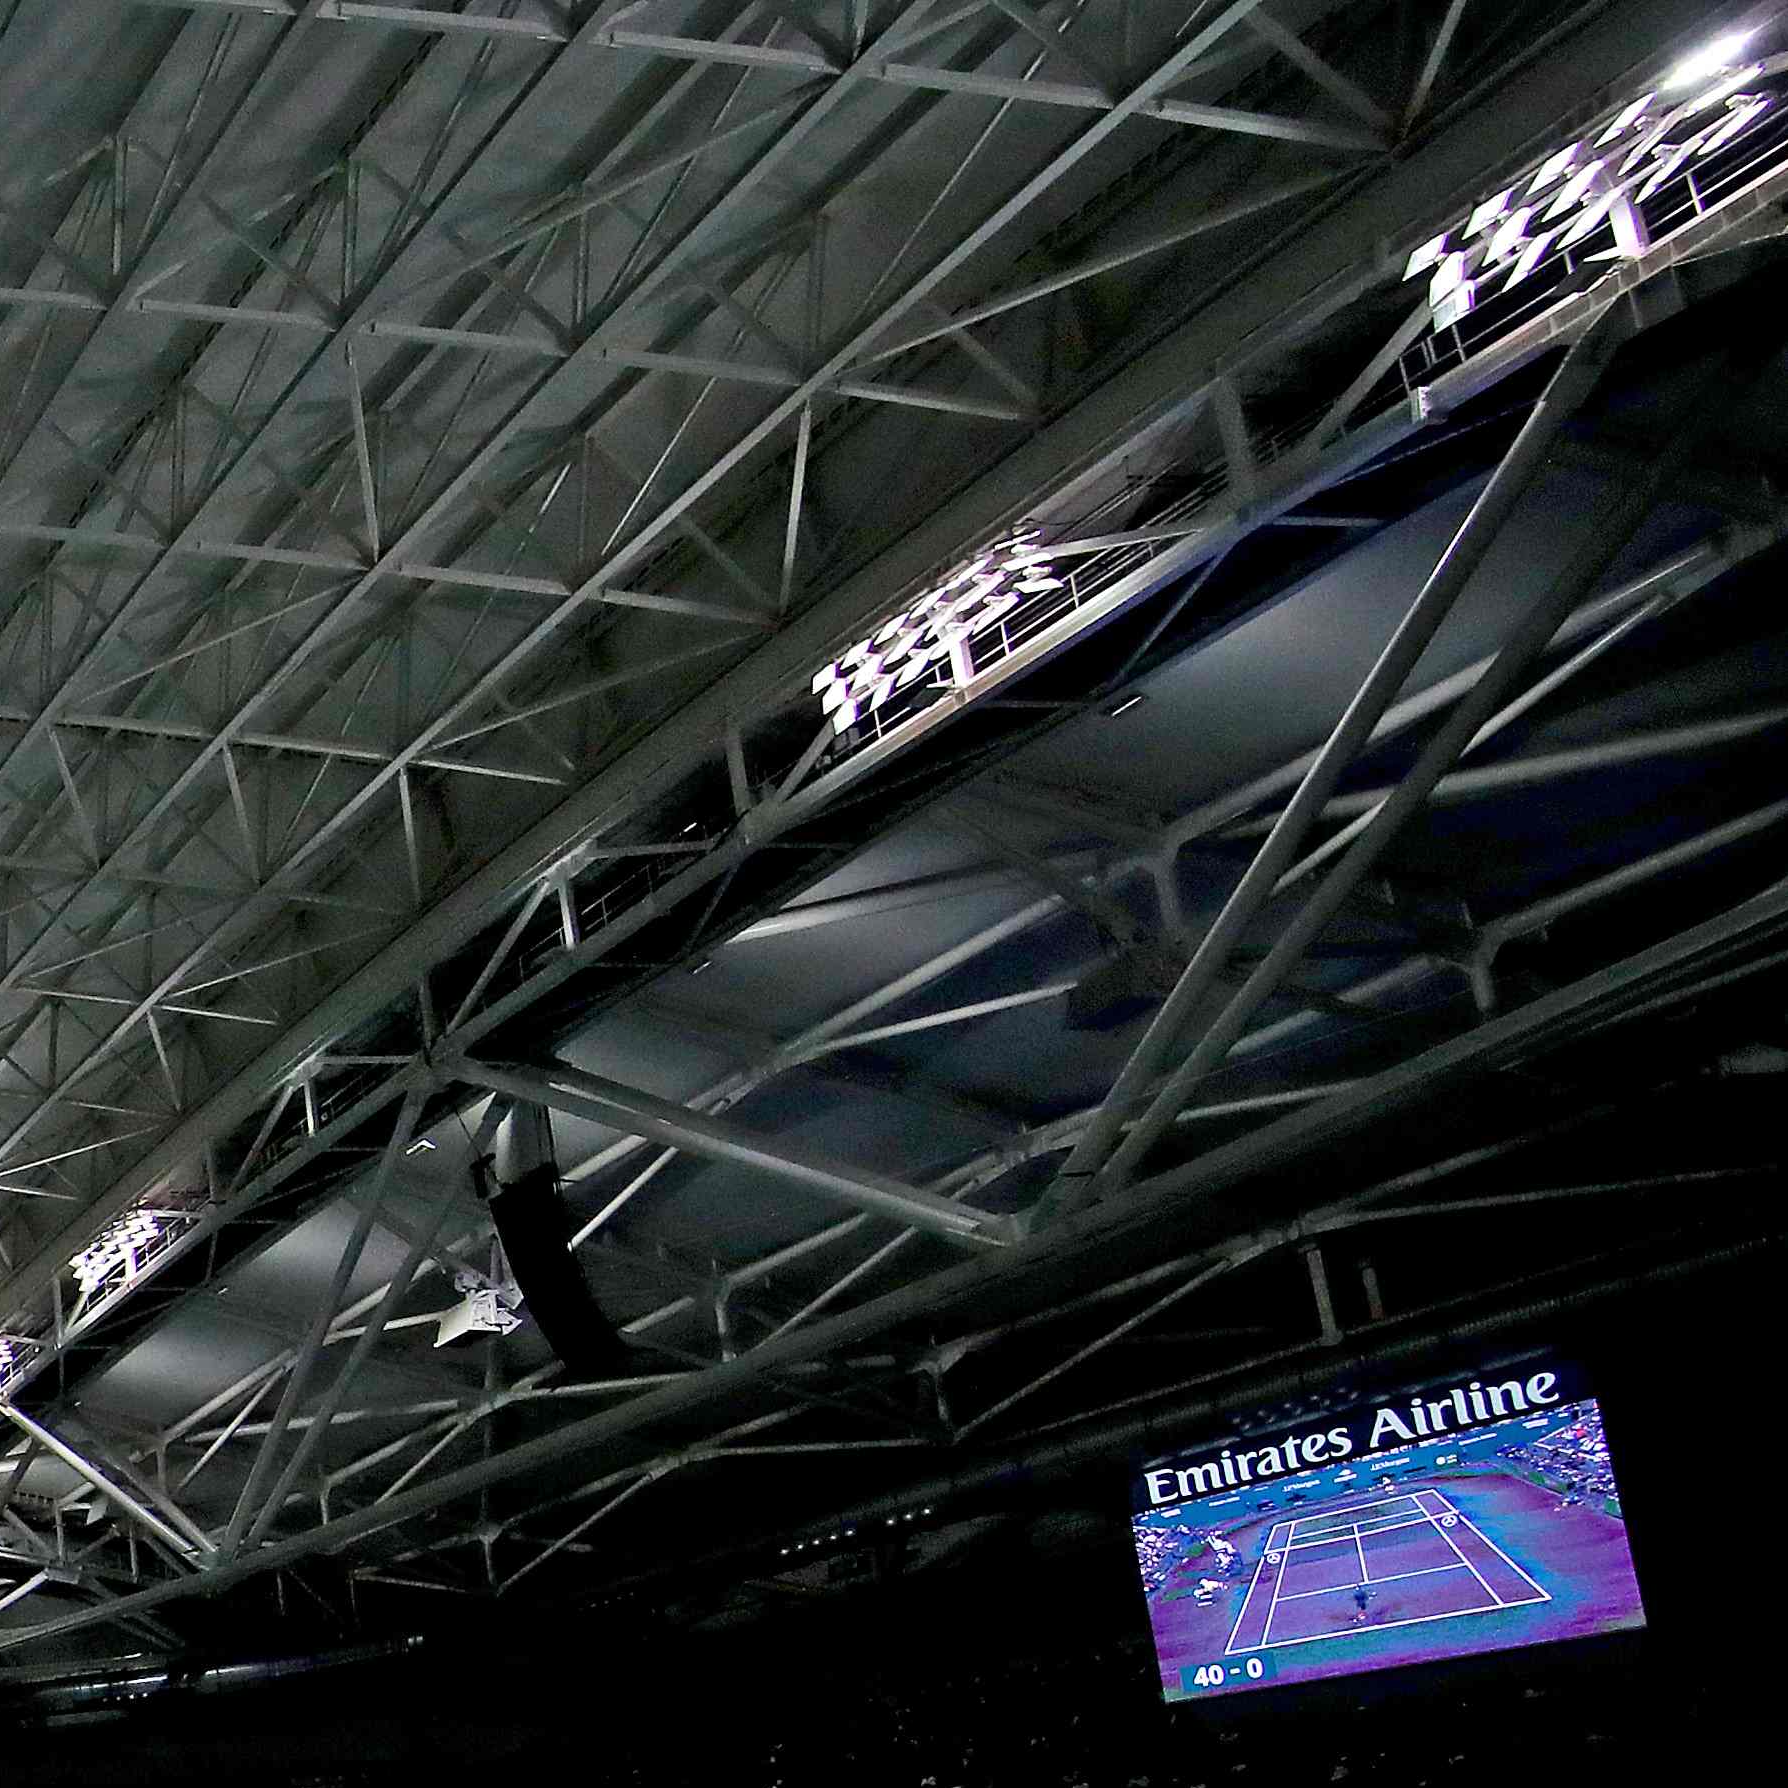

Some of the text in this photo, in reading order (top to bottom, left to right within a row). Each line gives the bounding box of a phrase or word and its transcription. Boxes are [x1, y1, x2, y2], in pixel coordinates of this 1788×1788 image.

[1144, 1371, 1561, 1505] Emirates Airline
[1193, 1663, 1224, 1688] 40
[1246, 1657, 1263, 1680] 0
